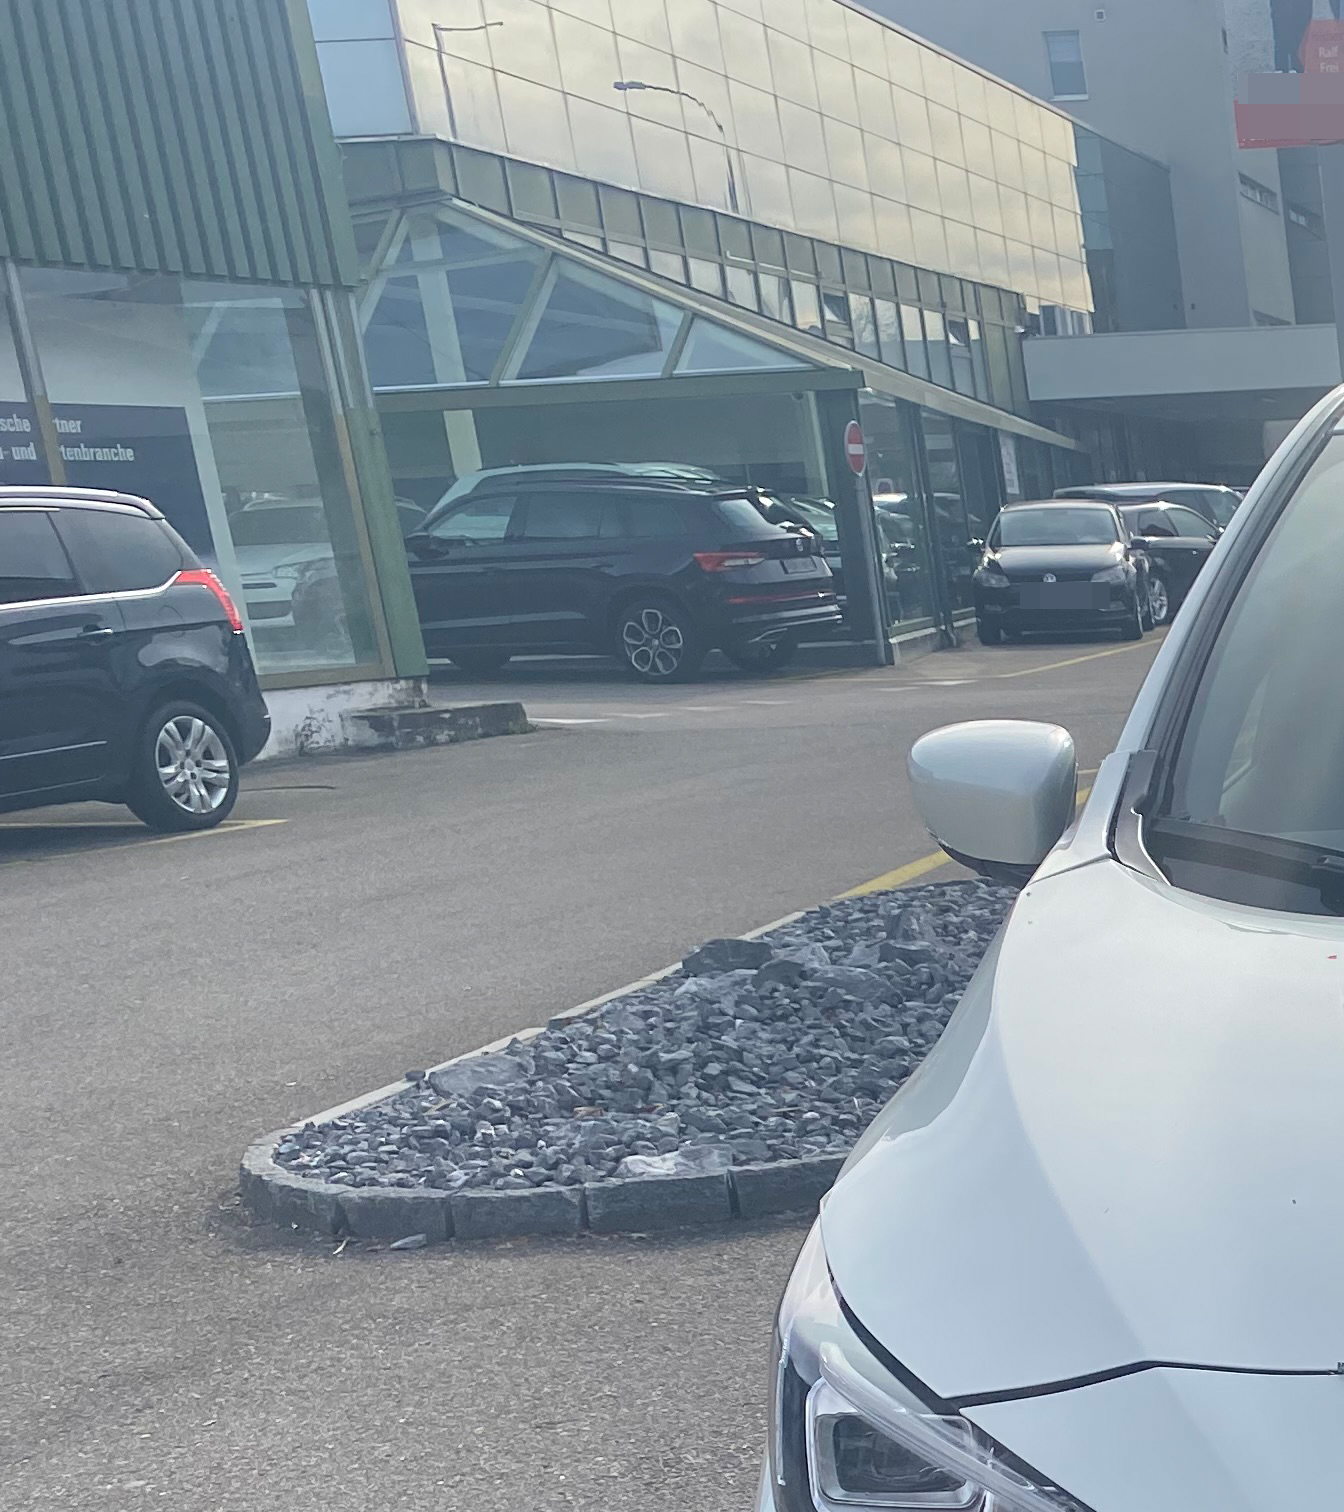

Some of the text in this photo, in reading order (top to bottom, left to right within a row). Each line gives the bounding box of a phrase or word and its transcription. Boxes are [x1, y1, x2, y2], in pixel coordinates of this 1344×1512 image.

[0, 414, 31, 432] sche
[11, 442, 37, 461] und
[60, 443, 135, 461] tenbranche
